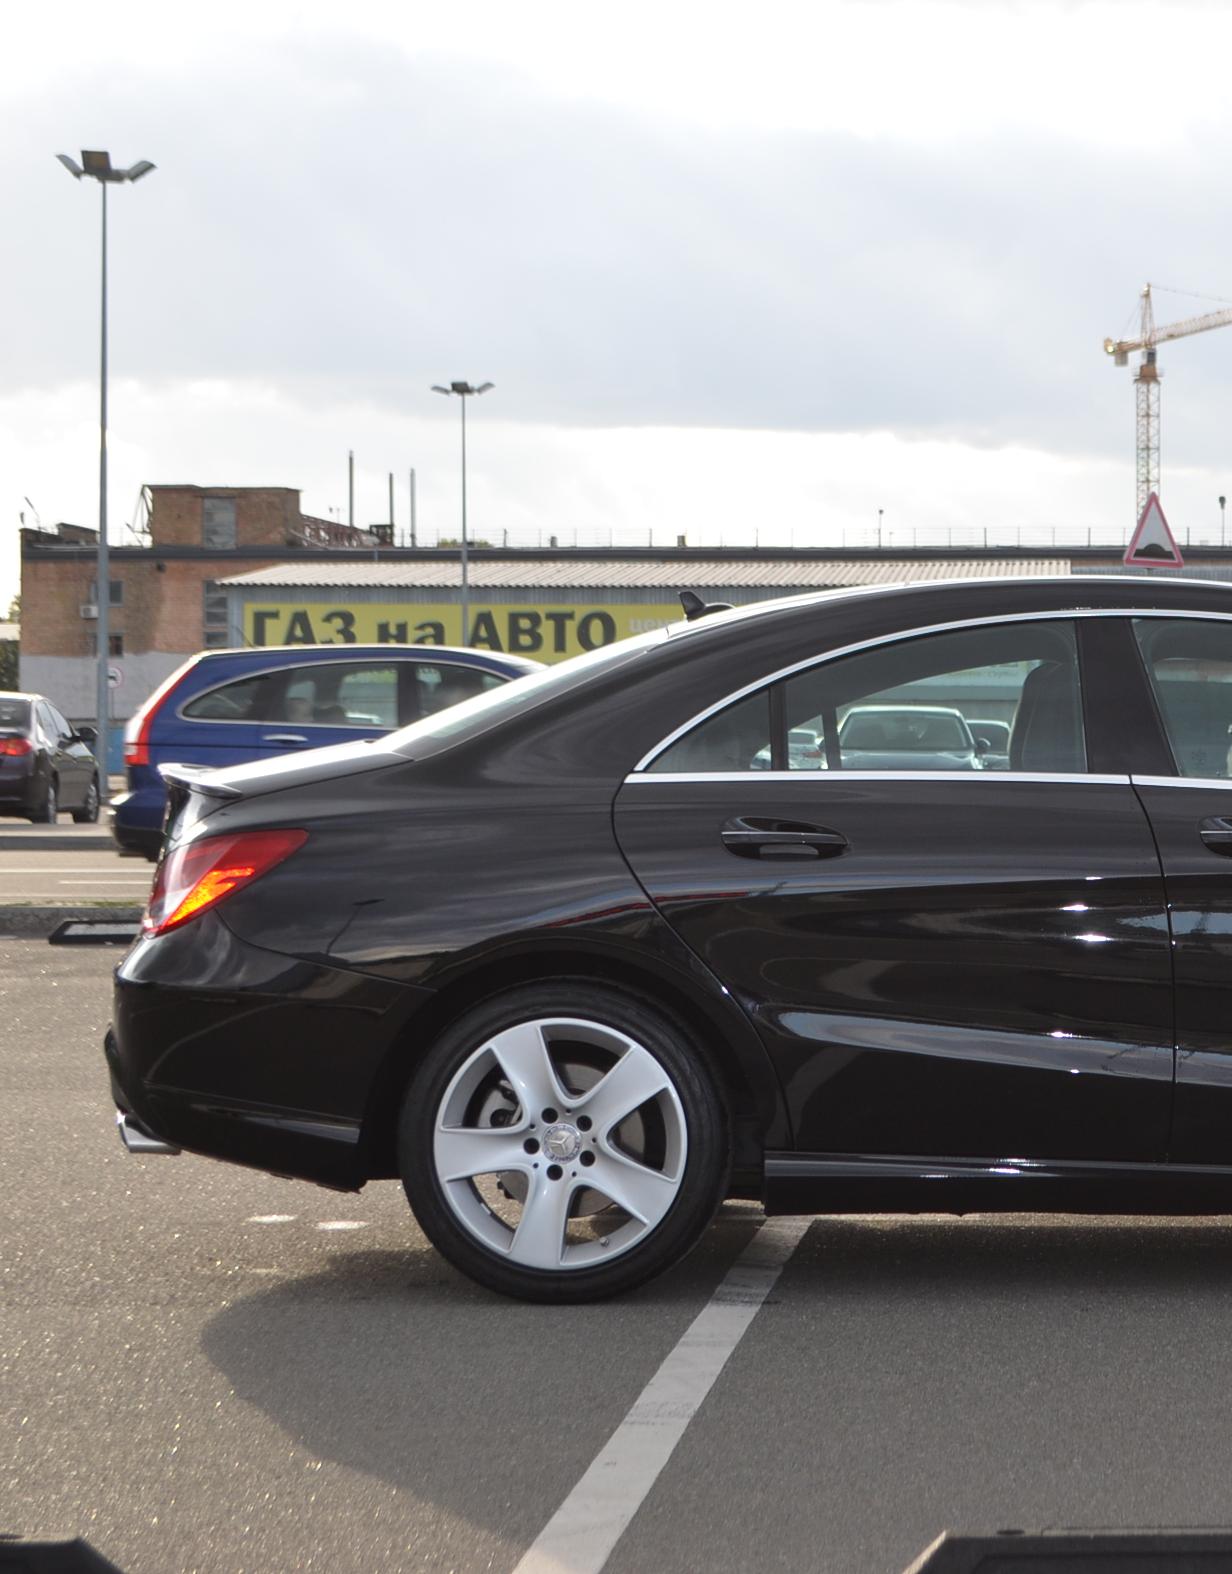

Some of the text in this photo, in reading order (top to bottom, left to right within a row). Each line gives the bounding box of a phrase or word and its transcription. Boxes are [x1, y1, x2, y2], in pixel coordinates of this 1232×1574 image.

[253, 610, 617, 653] ГАЗ на АВТО
